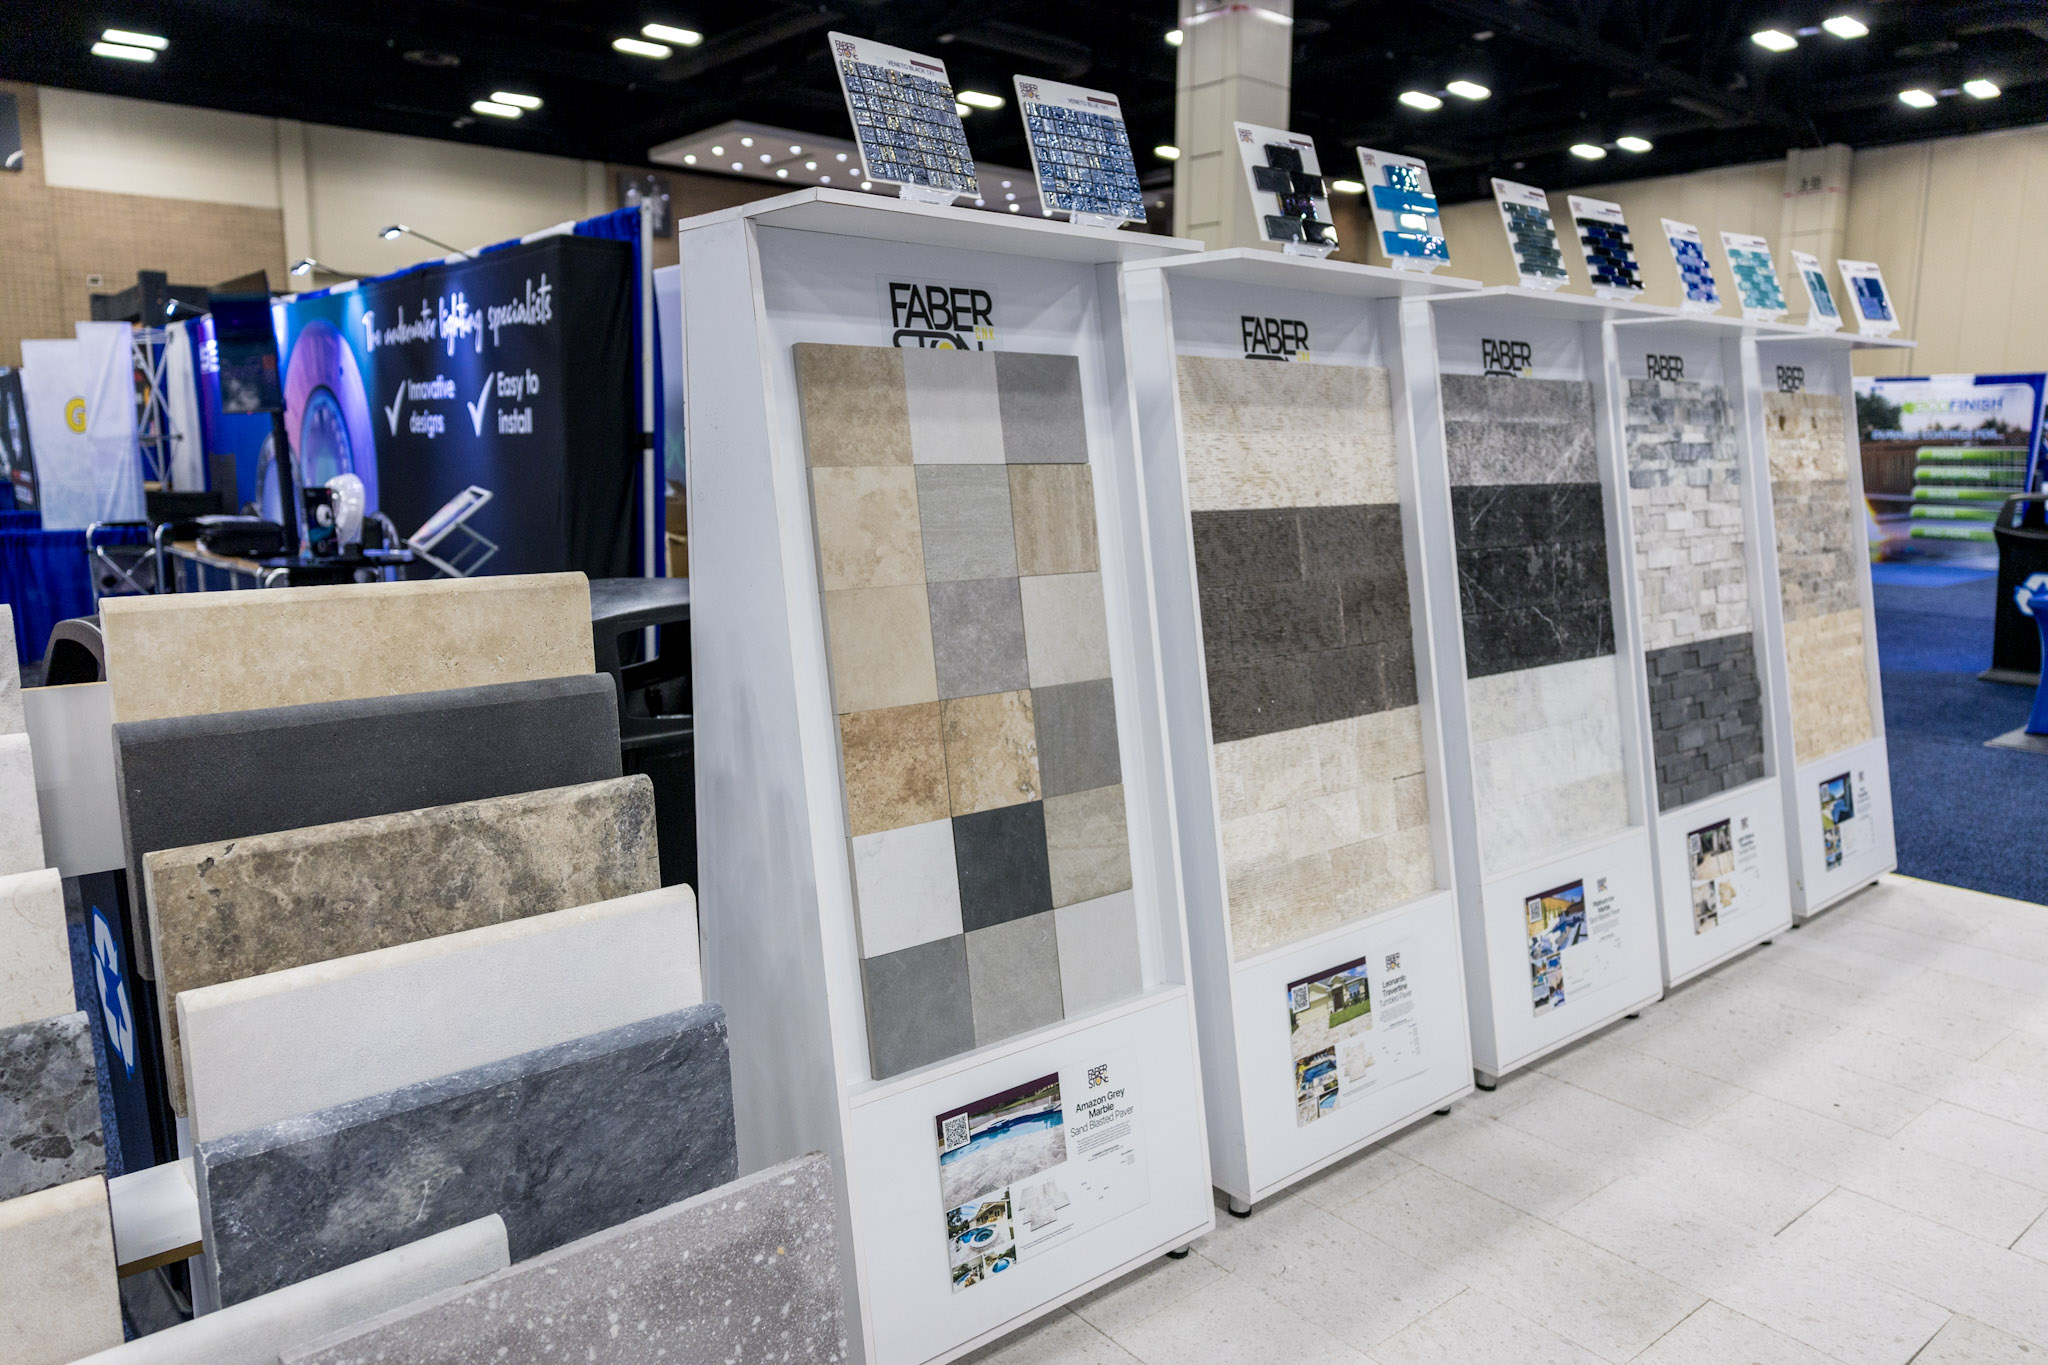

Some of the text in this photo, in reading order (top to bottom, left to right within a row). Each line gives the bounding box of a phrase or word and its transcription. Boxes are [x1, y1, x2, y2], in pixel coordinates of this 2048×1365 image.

[439, 291, 484, 357] lighting
[488, 272, 552, 347] specialists
[889, 282, 994, 332] FABER
[1241, 315, 1310, 355] FABER
[1481, 338, 1532, 371] FABER
[1646, 354, 1684, 381] FABER
[407, 374, 456, 401] Innovative
[497, 368, 540, 402] Easy to
[409, 409, 445, 439] designs
[497, 407, 533, 434] install
[1088, 1064, 1108, 1079] FABER
[1076, 1088, 1125, 1113] Amazon Grey
[1088, 1103, 1114, 1119] Marble
[1070, 1123, 1088, 1137] Sand
[1089, 1113, 1114, 1130] Blasted
[1115, 1105, 1134, 1119] Paver
